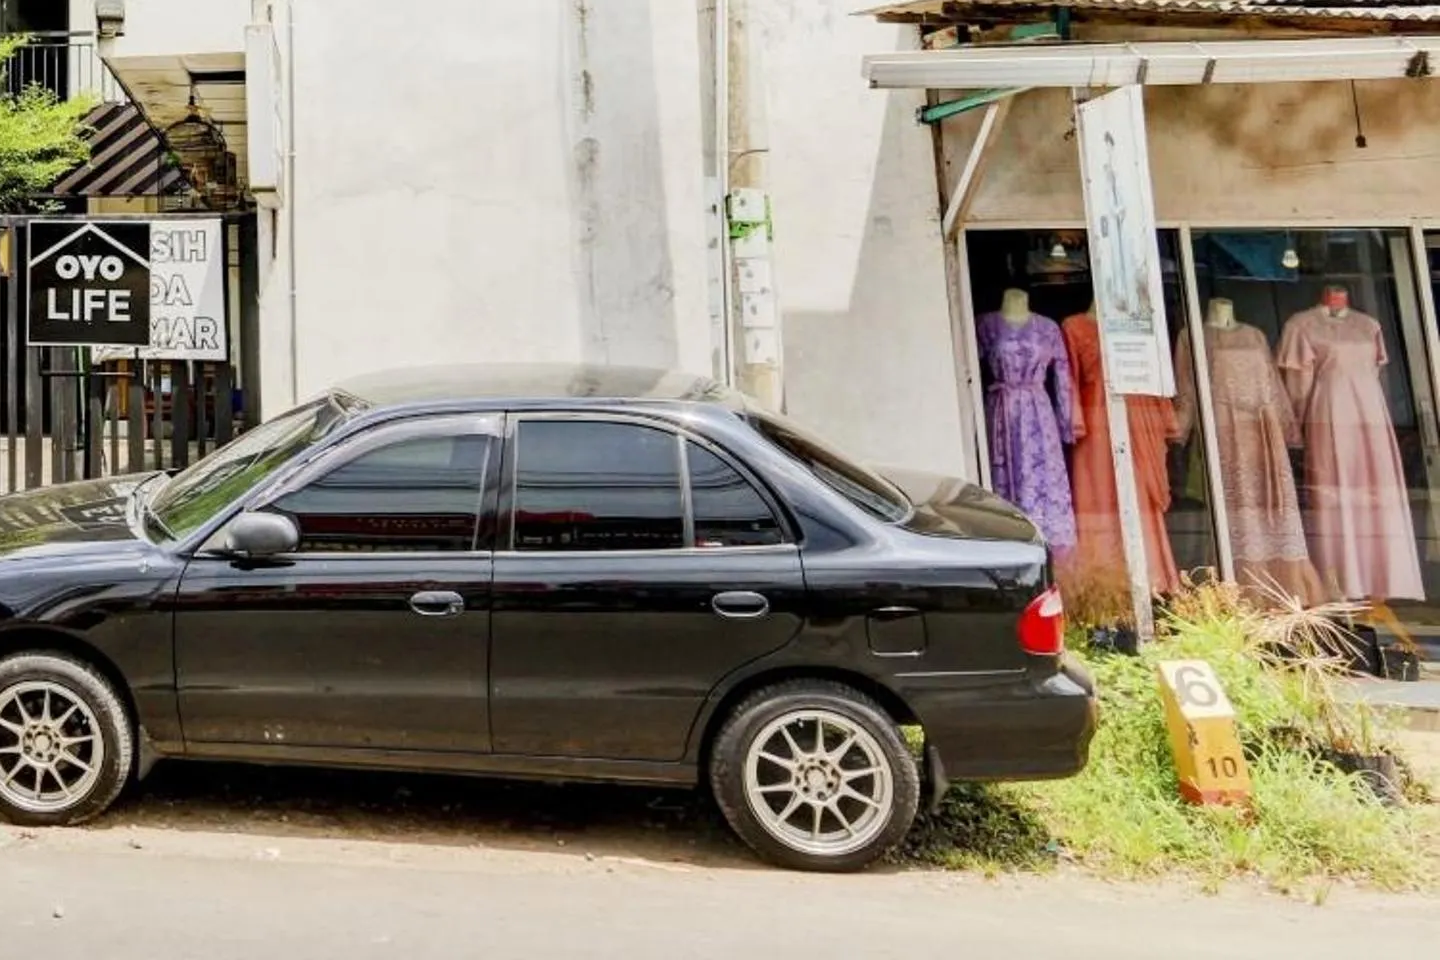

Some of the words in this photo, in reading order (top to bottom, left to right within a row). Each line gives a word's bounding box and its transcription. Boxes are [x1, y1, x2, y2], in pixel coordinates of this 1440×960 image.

[55, 254, 125, 281] OYO
[47, 287, 131, 321] LIFE
[1174, 666, 1218, 707] 6
[1207, 756, 1238, 778] 10
